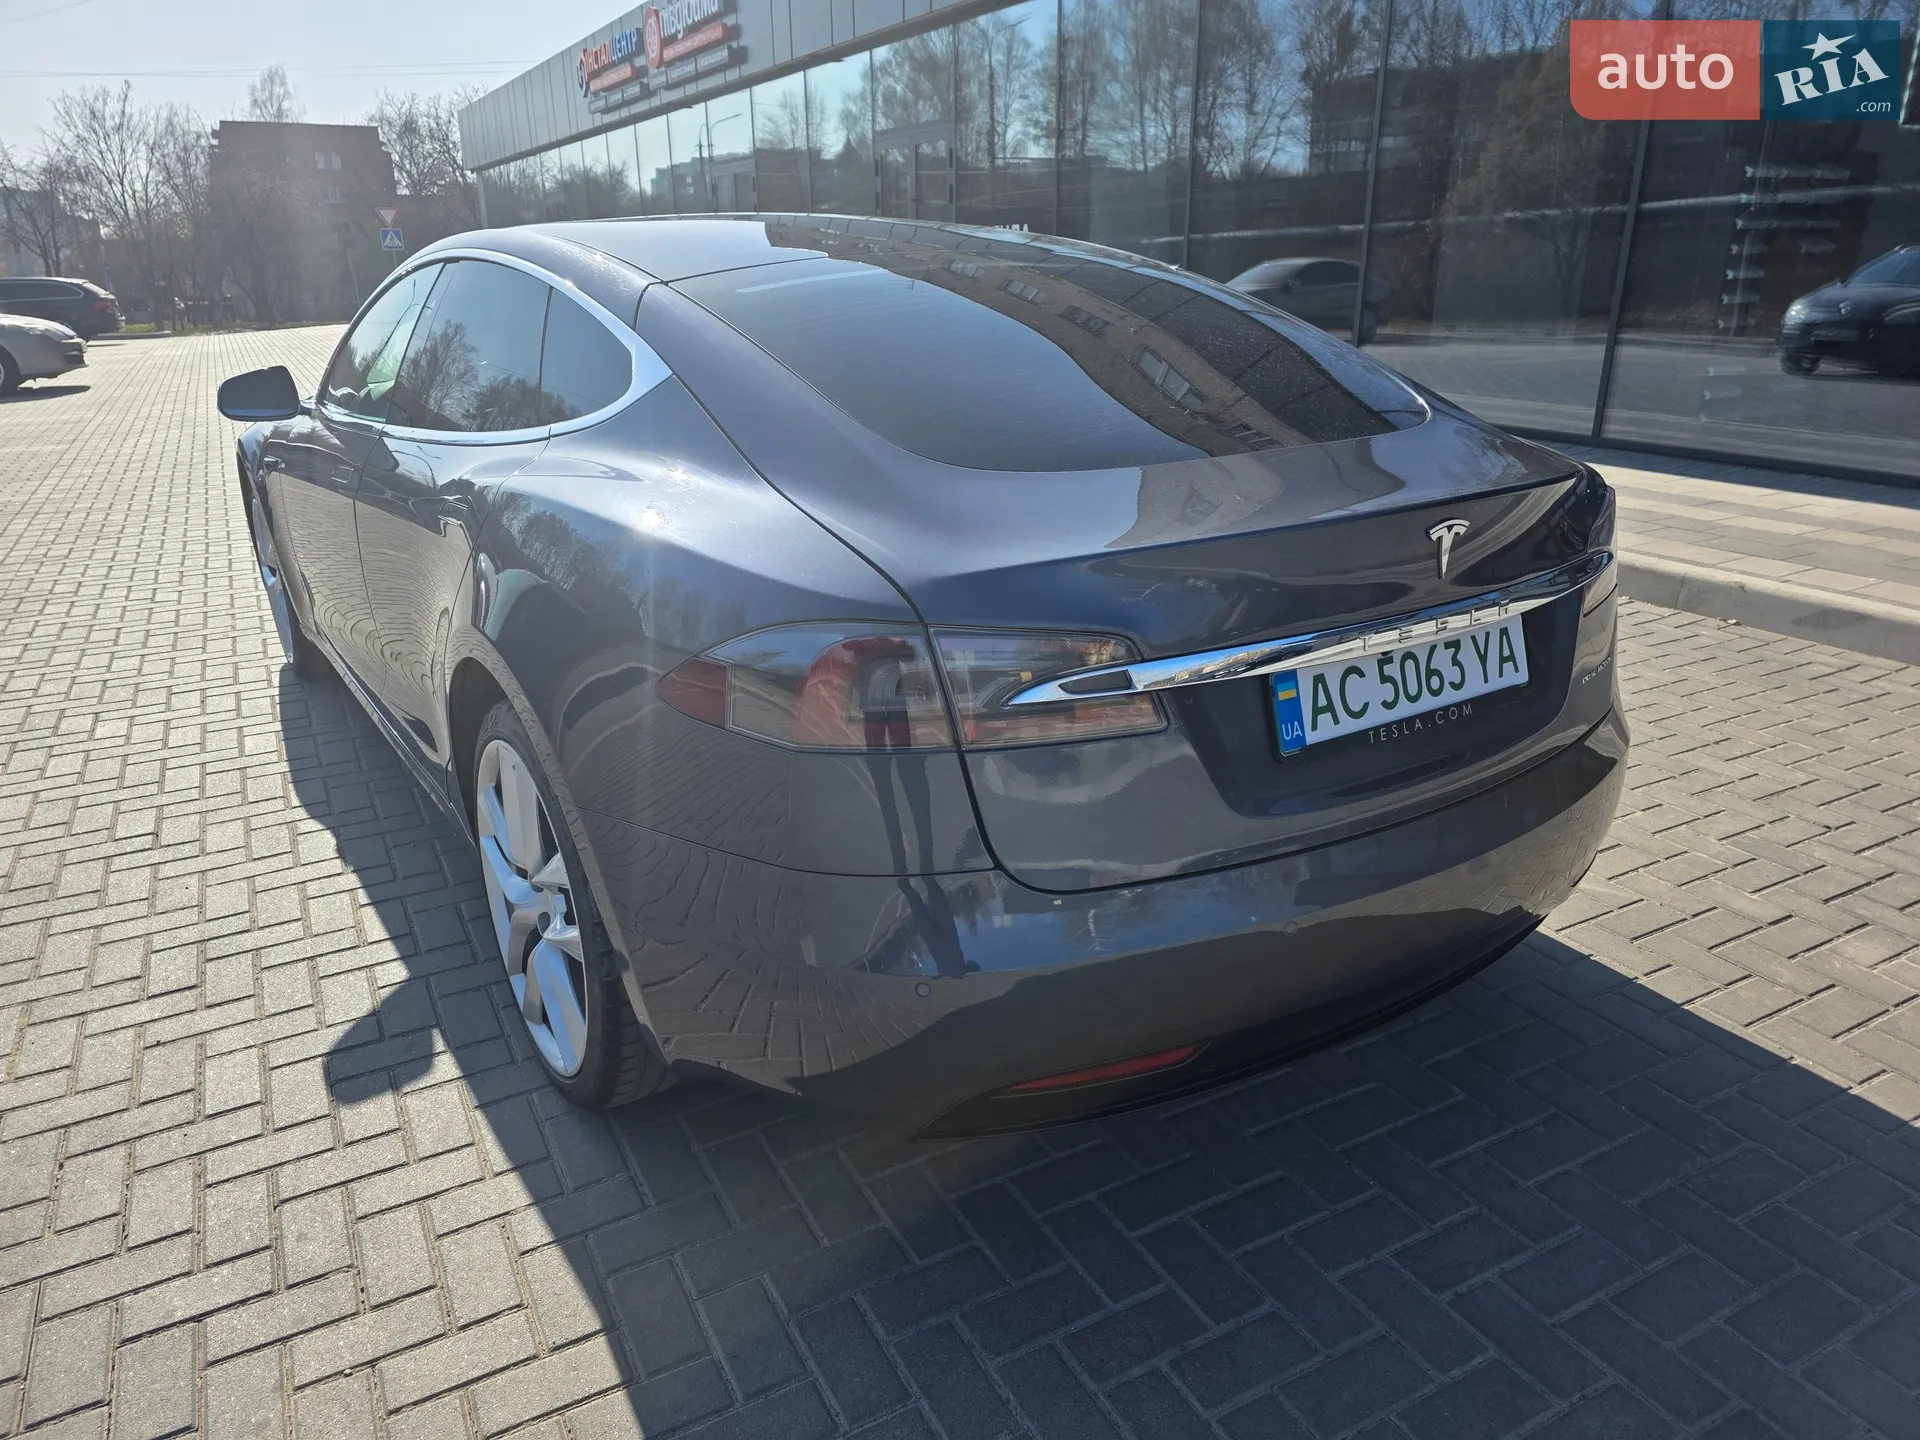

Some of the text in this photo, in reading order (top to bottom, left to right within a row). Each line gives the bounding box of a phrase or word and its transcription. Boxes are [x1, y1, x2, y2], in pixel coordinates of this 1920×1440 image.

[1356, 598, 1511, 652] TESLA
[1311, 664, 1369, 732] AC
[1377, 640, 1465, 711] 5063
[1470, 626, 1519, 683] YA
[1282, 720, 1303, 741] UA
[1368, 703, 1473, 744] TESLA.COM
